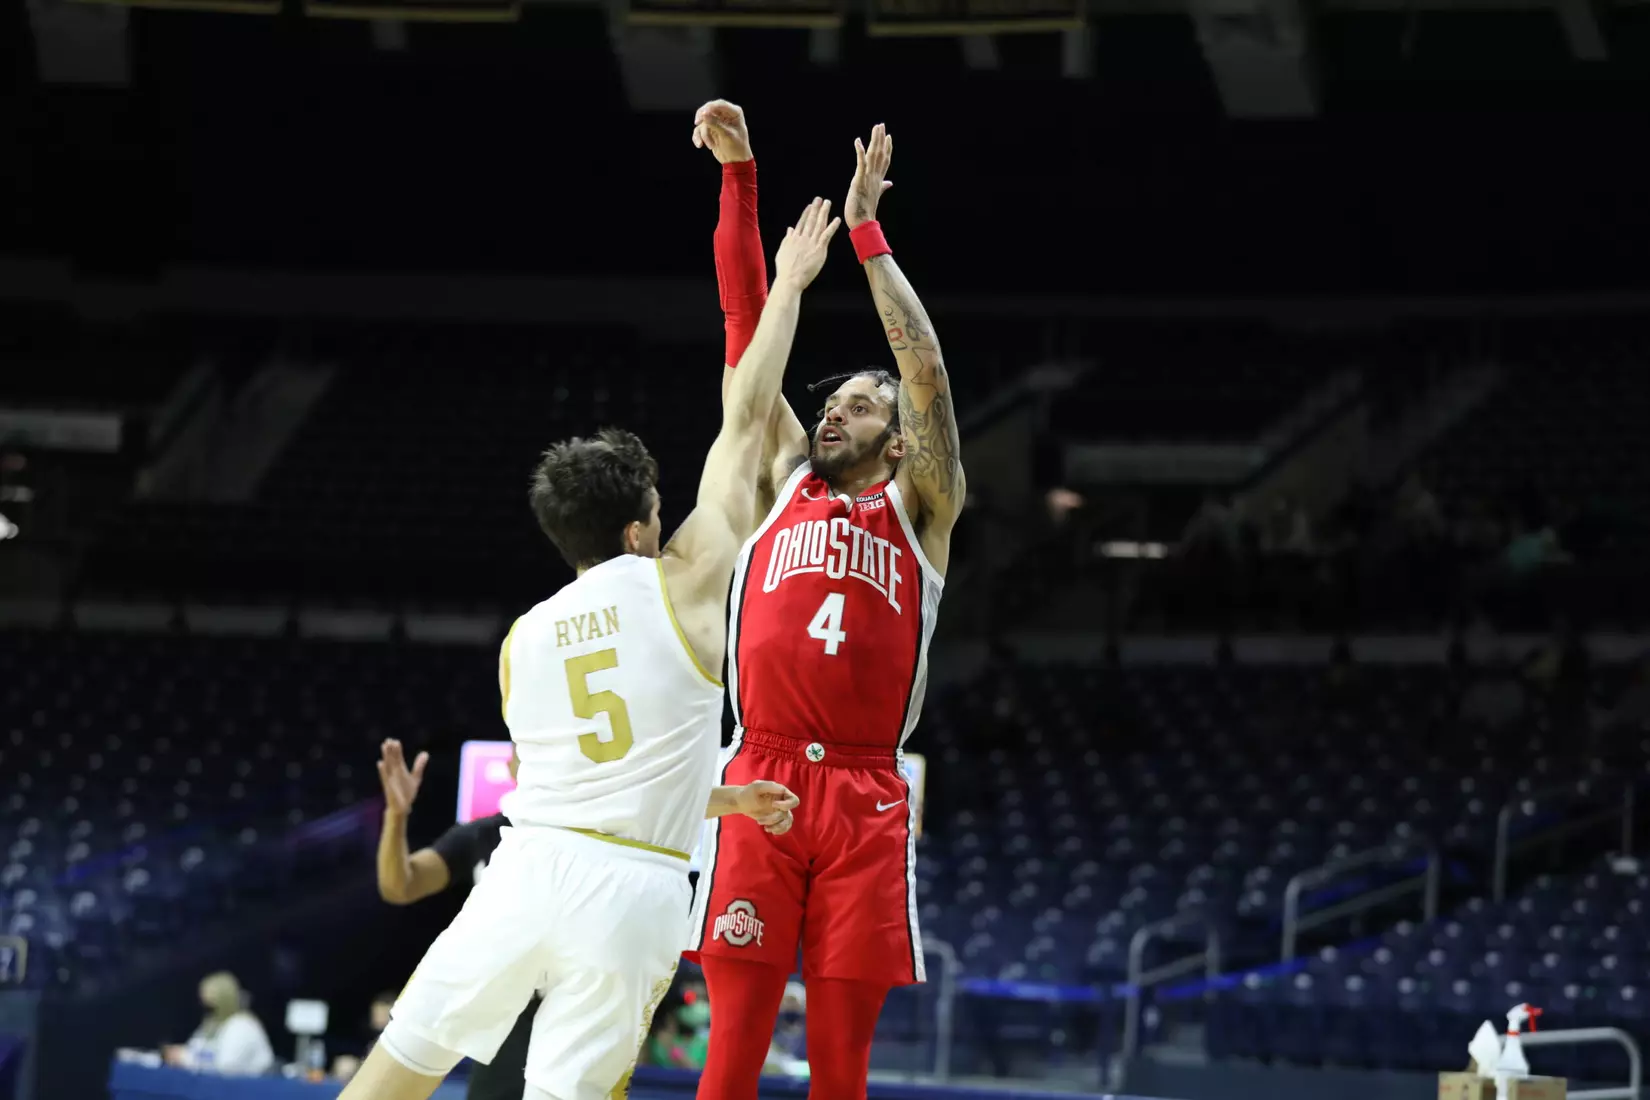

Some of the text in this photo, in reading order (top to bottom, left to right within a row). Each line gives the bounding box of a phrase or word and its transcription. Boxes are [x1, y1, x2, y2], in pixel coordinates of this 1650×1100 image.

[855, 491, 885, 503] EQUALITY
[554, 605, 621, 648] RYAN
[806, 592, 847, 656] 4
[564, 647, 635, 764] 5
